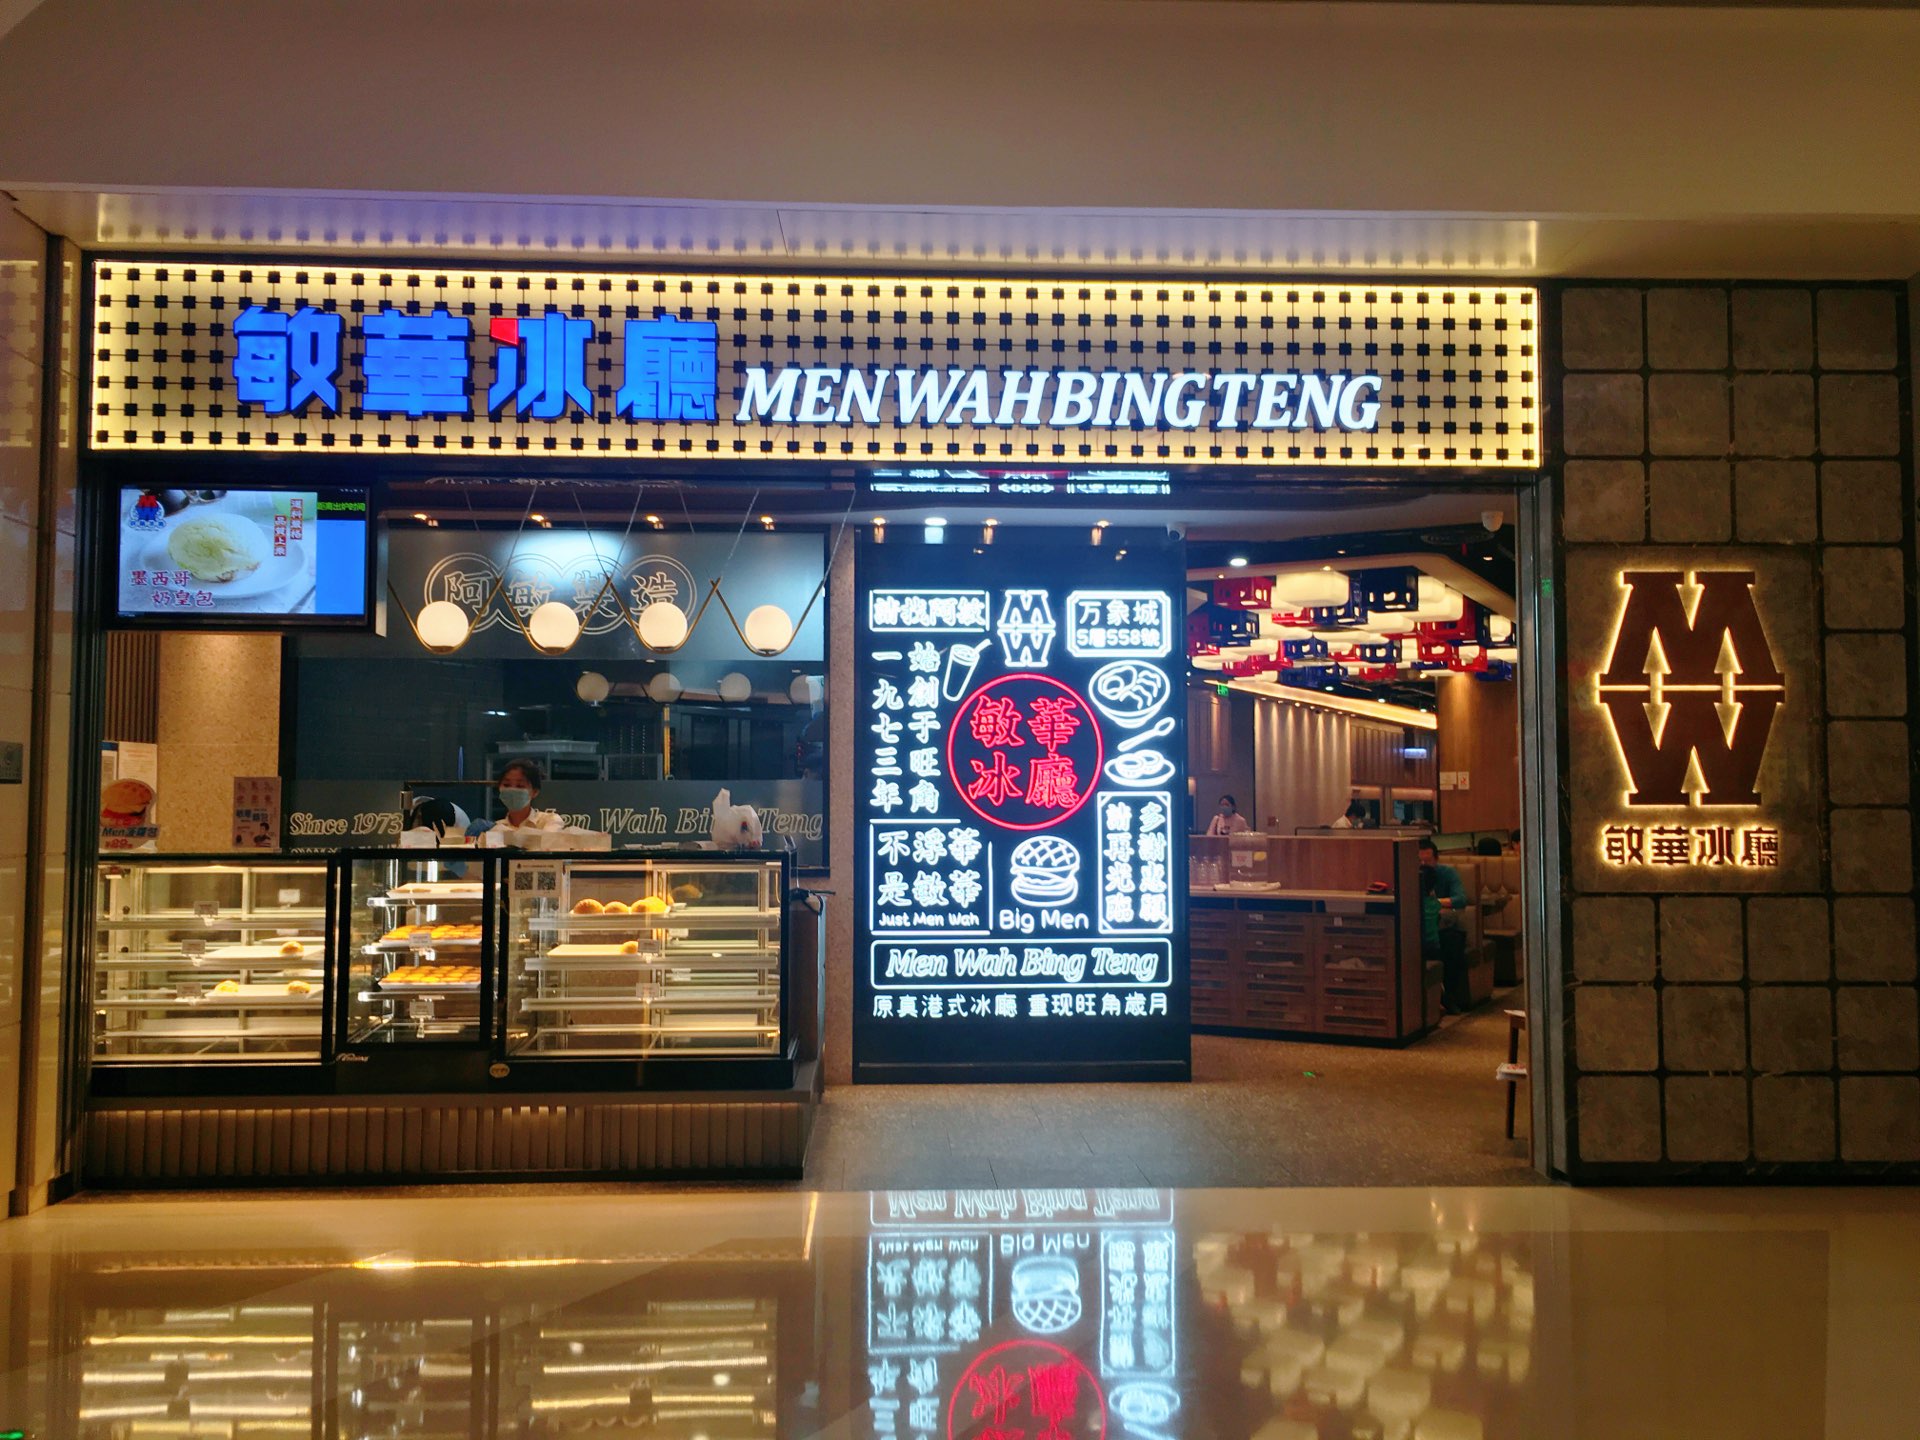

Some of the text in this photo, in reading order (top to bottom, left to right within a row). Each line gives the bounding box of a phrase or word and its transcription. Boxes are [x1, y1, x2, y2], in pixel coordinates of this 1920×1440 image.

[232, 304, 720, 422] 敏華冰廳
[131, 570, 191, 587] 墨西哥
[152, 590, 214, 608] 奶皇包
[1078, 597, 1160, 627] 万象城
[870, 651, 904, 813] 一九七三年
[289, 811, 348, 836] Since
[351, 812, 404, 836] 1973
[600, 806, 667, 834] Wah
[758, 807, 823, 841] Teng
[877, 826, 982, 867] 不浮華
[1103, 801, 1136, 923] 請再光臨
[1601, 823, 1780, 868] 敏華冰廳
[877, 869, 983, 909] 是敏華
[879, 912, 980, 927] Just Men Wah
[999, 907, 1090, 933] Big Men
[885, 947, 1159, 982] Men Wah Bing Teng
[873, 993, 1018, 1019] 原真港式冰廳
